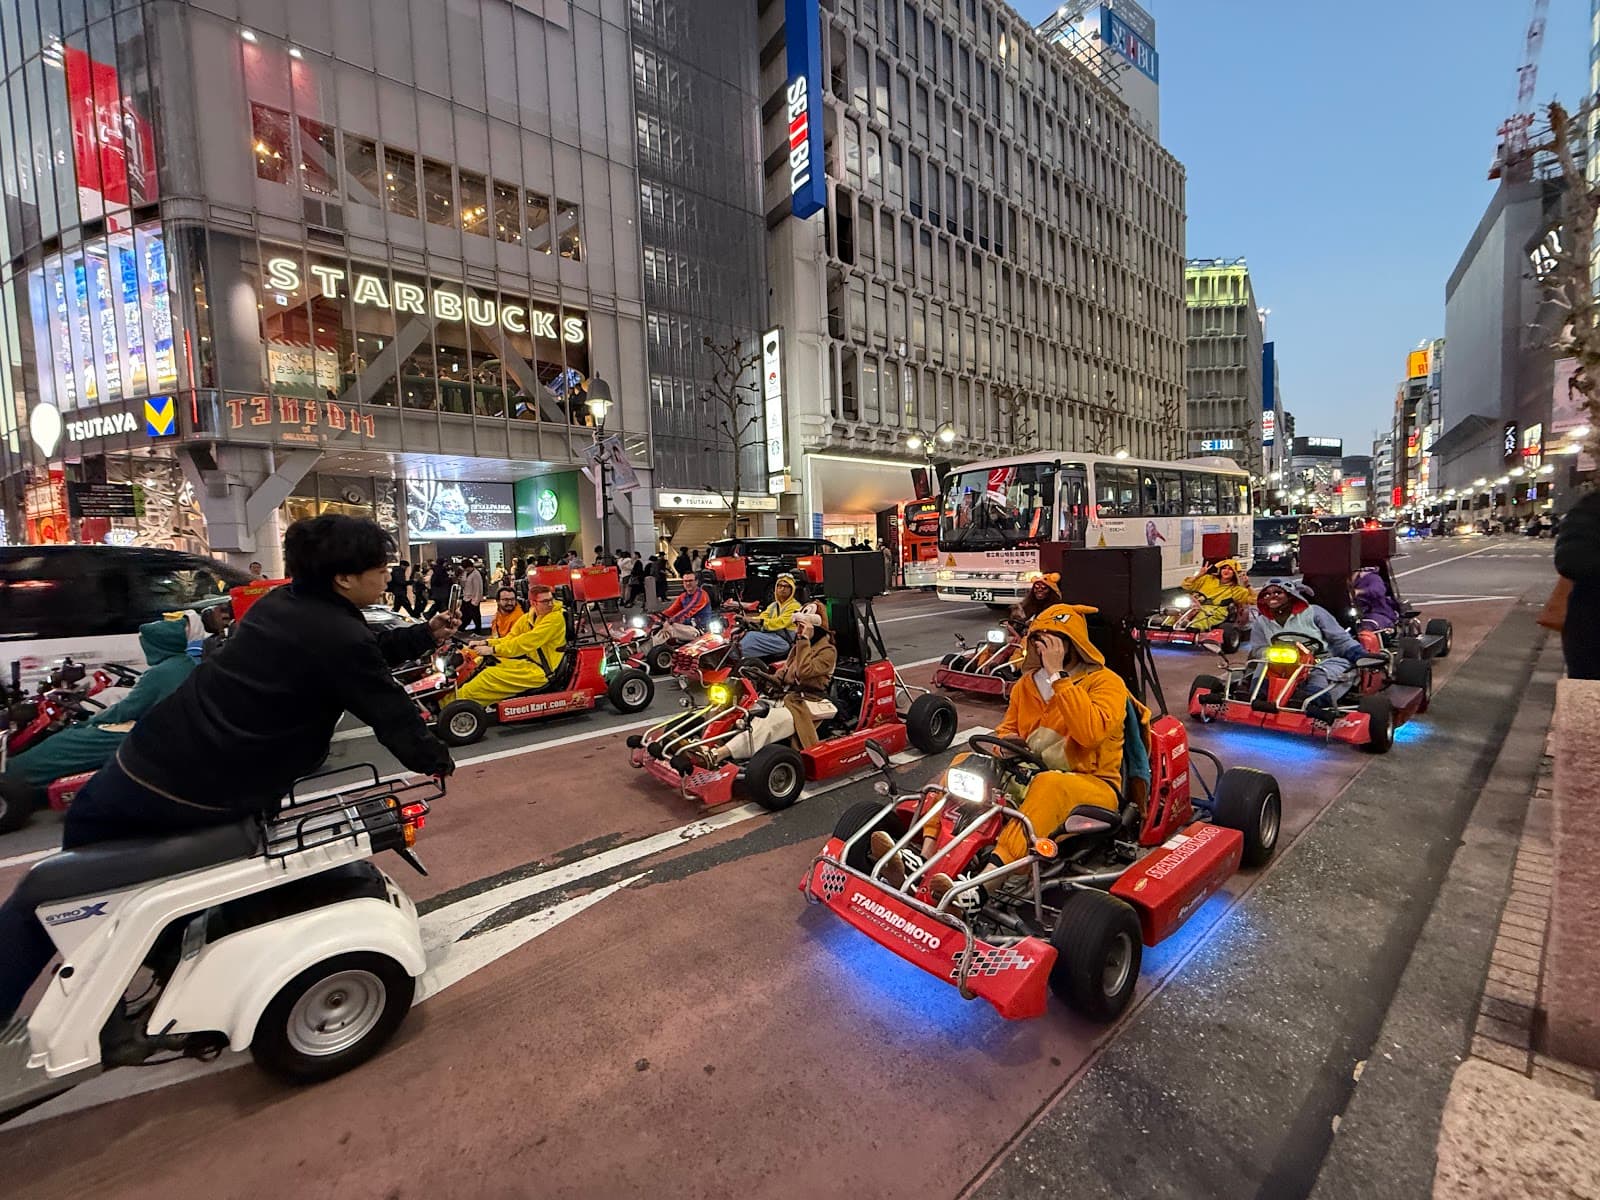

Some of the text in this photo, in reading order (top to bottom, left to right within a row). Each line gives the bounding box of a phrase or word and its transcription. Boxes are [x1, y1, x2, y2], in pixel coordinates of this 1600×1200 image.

[787, 75, 810, 194] SEIBU
[267, 257, 586, 344] STARBUCKS
[66, 412, 138, 442] TSUTAYA
[1201, 439, 1234, 451] SEIBU
[504, 705, 530, 716] Street
[530, 702, 547, 712] Kart
[46, 909, 81, 922] GYRO
